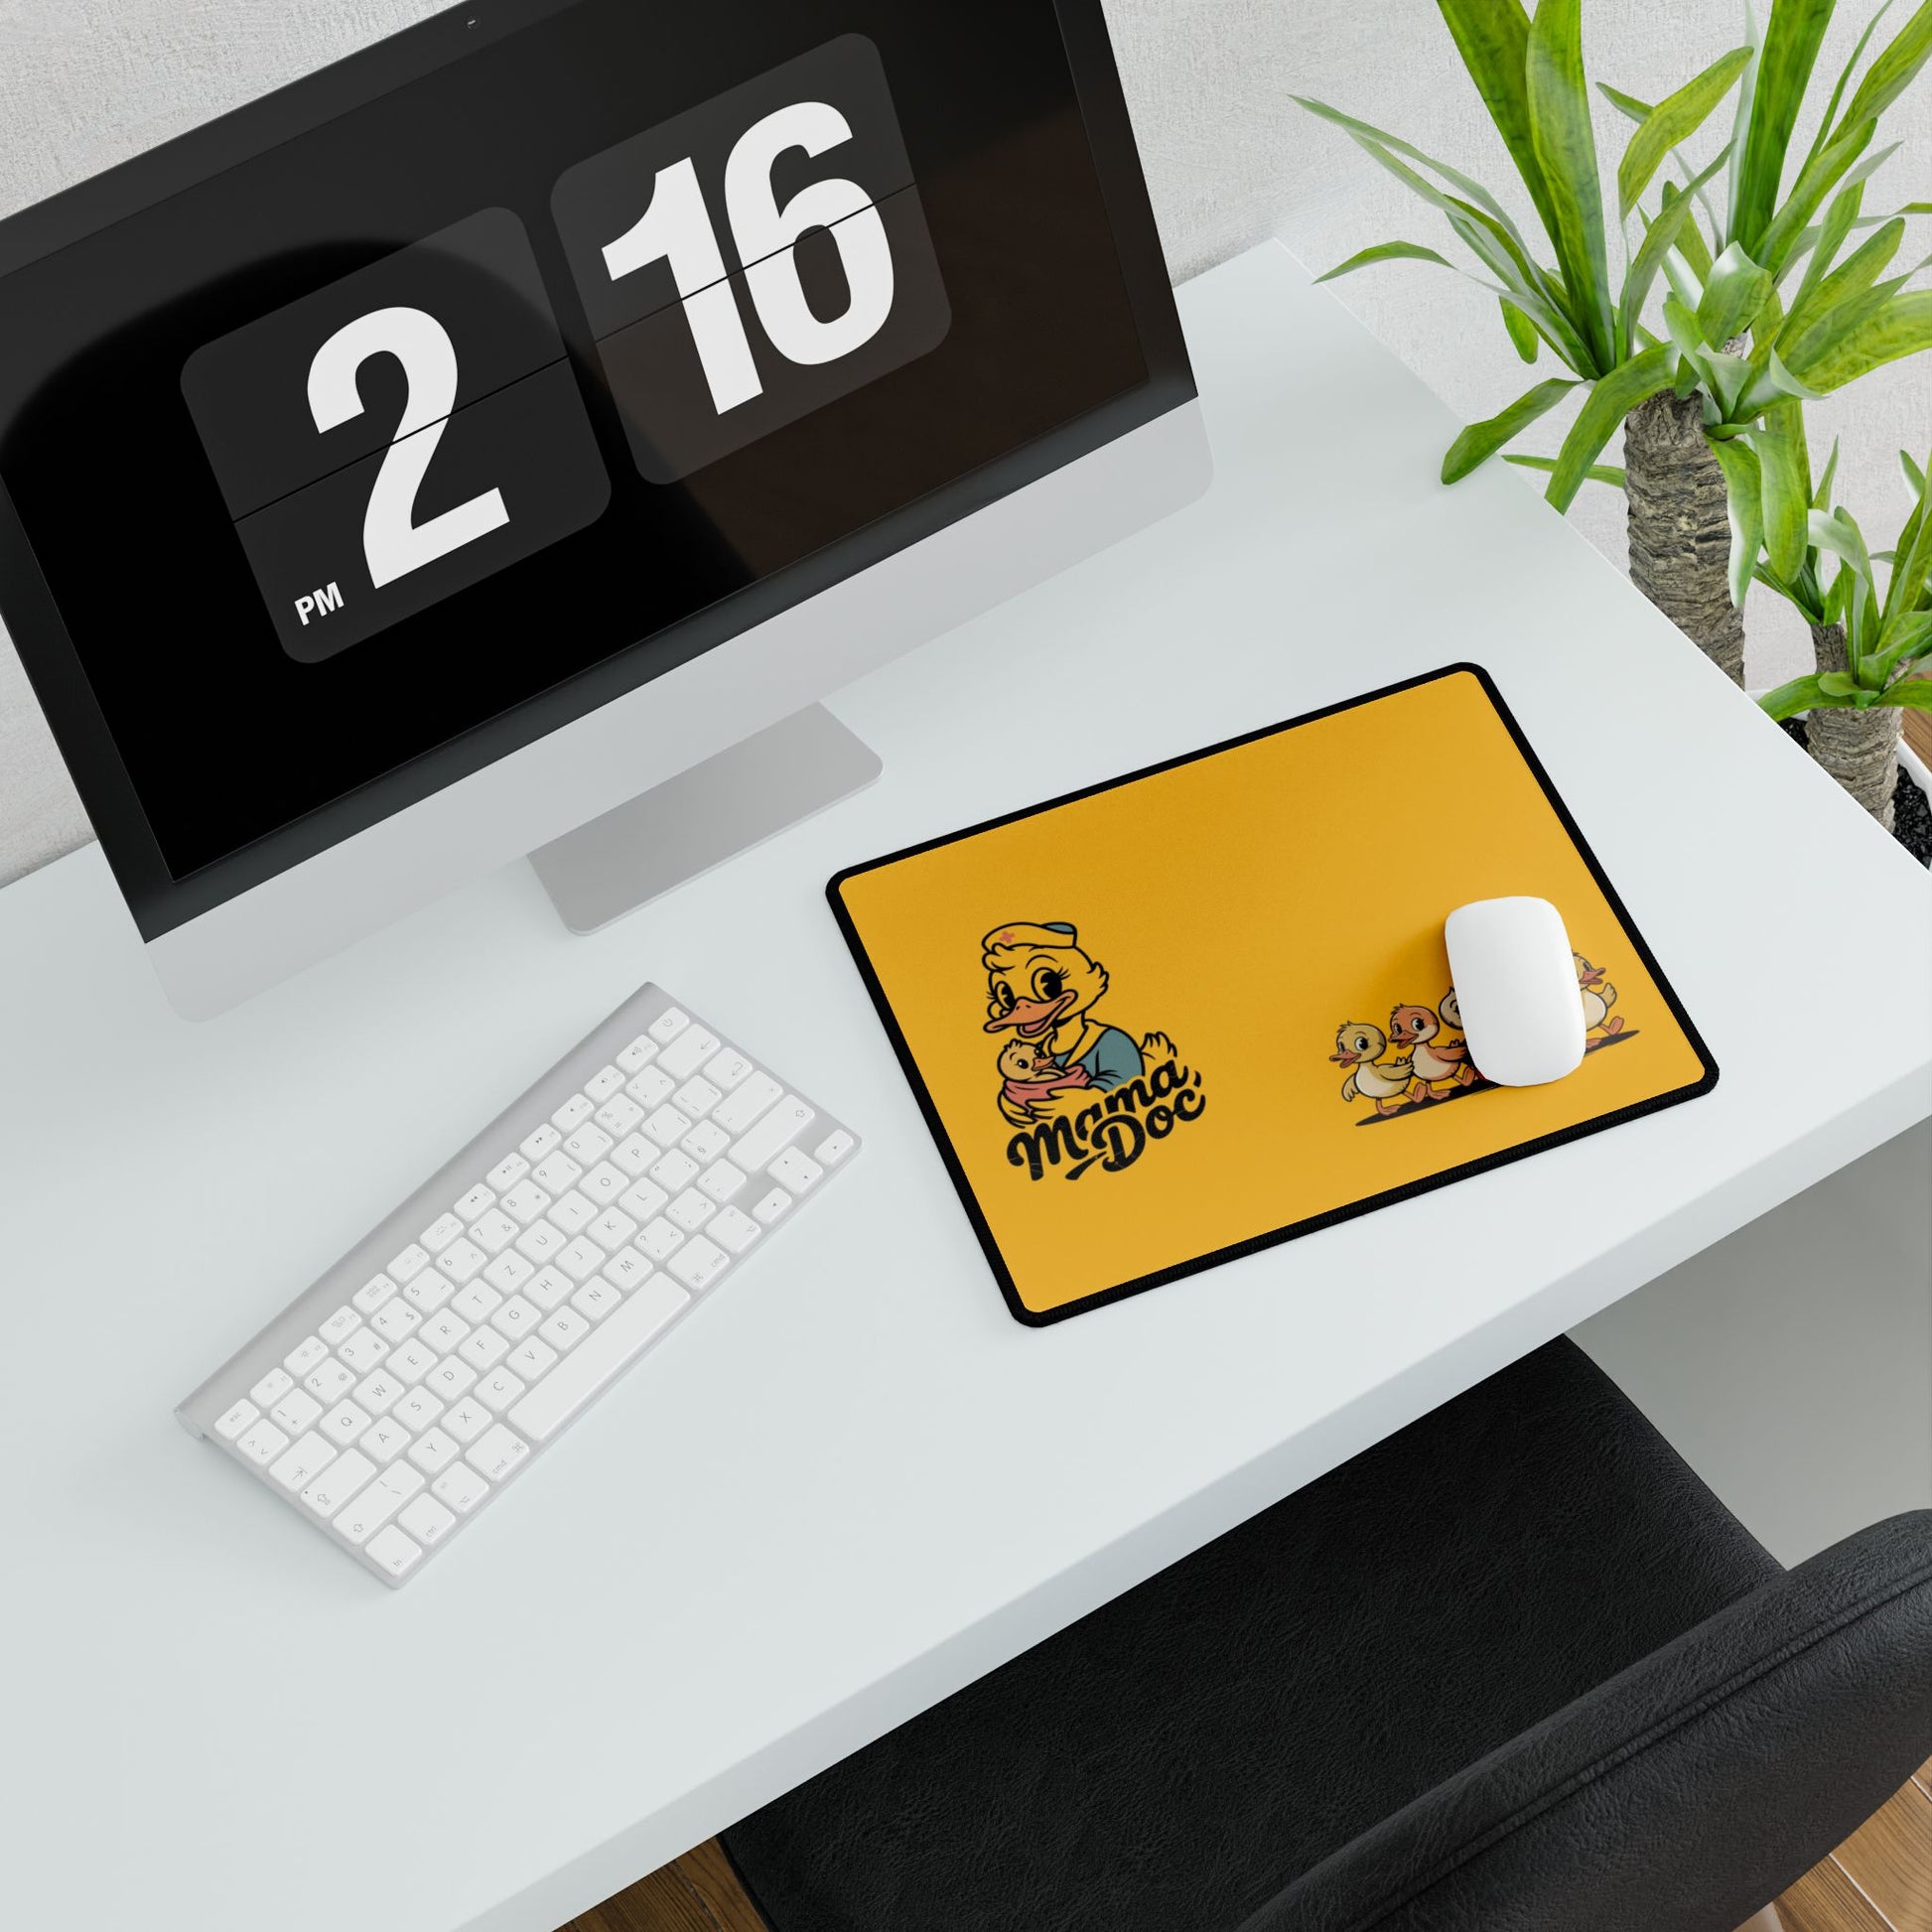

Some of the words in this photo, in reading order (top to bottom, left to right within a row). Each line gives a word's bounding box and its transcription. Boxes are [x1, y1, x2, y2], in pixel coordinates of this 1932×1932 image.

[307, 306, 510, 593] 2
[601, 101, 895, 415] 16
[294, 581, 345, 626] PM
[1007, 1059, 1188, 1180] Mama
[1090, 1088, 1206, 1173] Doc
[311, 1378, 322, 1387] 2
[345, 1347, 355, 1357] 3
[379, 1317, 387, 1325] 4
[410, 1287, 420, 1296] 5
[444, 1258, 453, 1267] 6
[474, 1227, 483, 1237] 7
[507, 1199, 517, 1207] 8
[341, 1417, 353, 1427] Q
[372, 1384, 386, 1397] W
[407, 1355, 418, 1365] E
[439, 1326, 450, 1335] R
[472, 1295, 482, 1304] T
[504, 1265, 516, 1276] Z
[535, 1235, 548, 1246] U
[600, 1177, 611, 1187] O
[631, 1148, 640, 1158] P
[378, 1433, 390, 1443] A
[410, 1401, 422, 1412] S
[443, 1371, 455, 1381] D
[476, 1340, 485, 1350] F
[509, 1310, 520, 1320] G
[540, 1279, 553, 1291] H
[574, 1250, 583, 1260] J
[604, 1221, 616, 1231] K
[426, 1443, 437, 1452] Y
[459, 1412, 472, 1423] X
[493, 1381, 504, 1391] C
[524, 1350, 535, 1360] V
[557, 1322, 568, 1331] B
[589, 1290, 602, 1301] N
[620, 1260, 634, 1273] M
